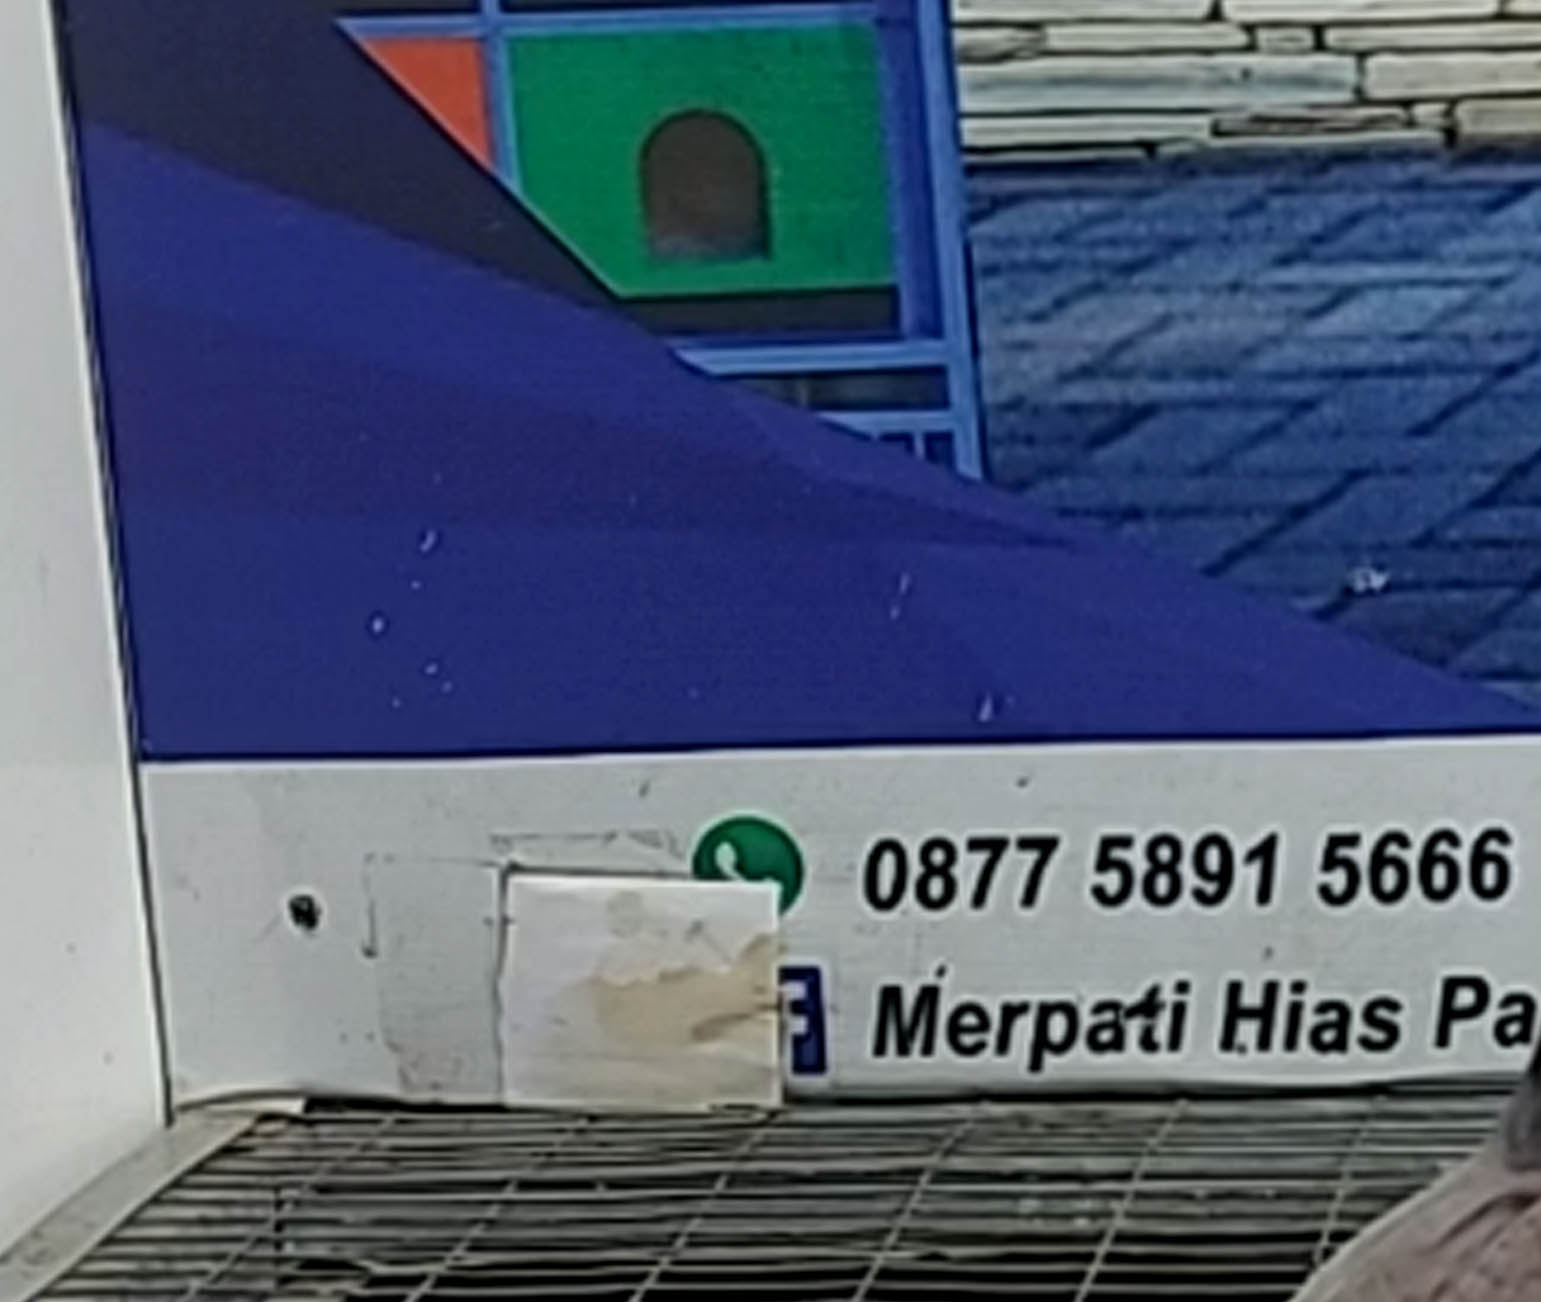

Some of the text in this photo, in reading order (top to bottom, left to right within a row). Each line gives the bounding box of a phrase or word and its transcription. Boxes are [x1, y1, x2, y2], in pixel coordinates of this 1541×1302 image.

[863, 827, 1513, 913] 0877 5891 5666
[871, 979, 1192, 1075] Merpati
[1218, 979, 1404, 1056] Hias
